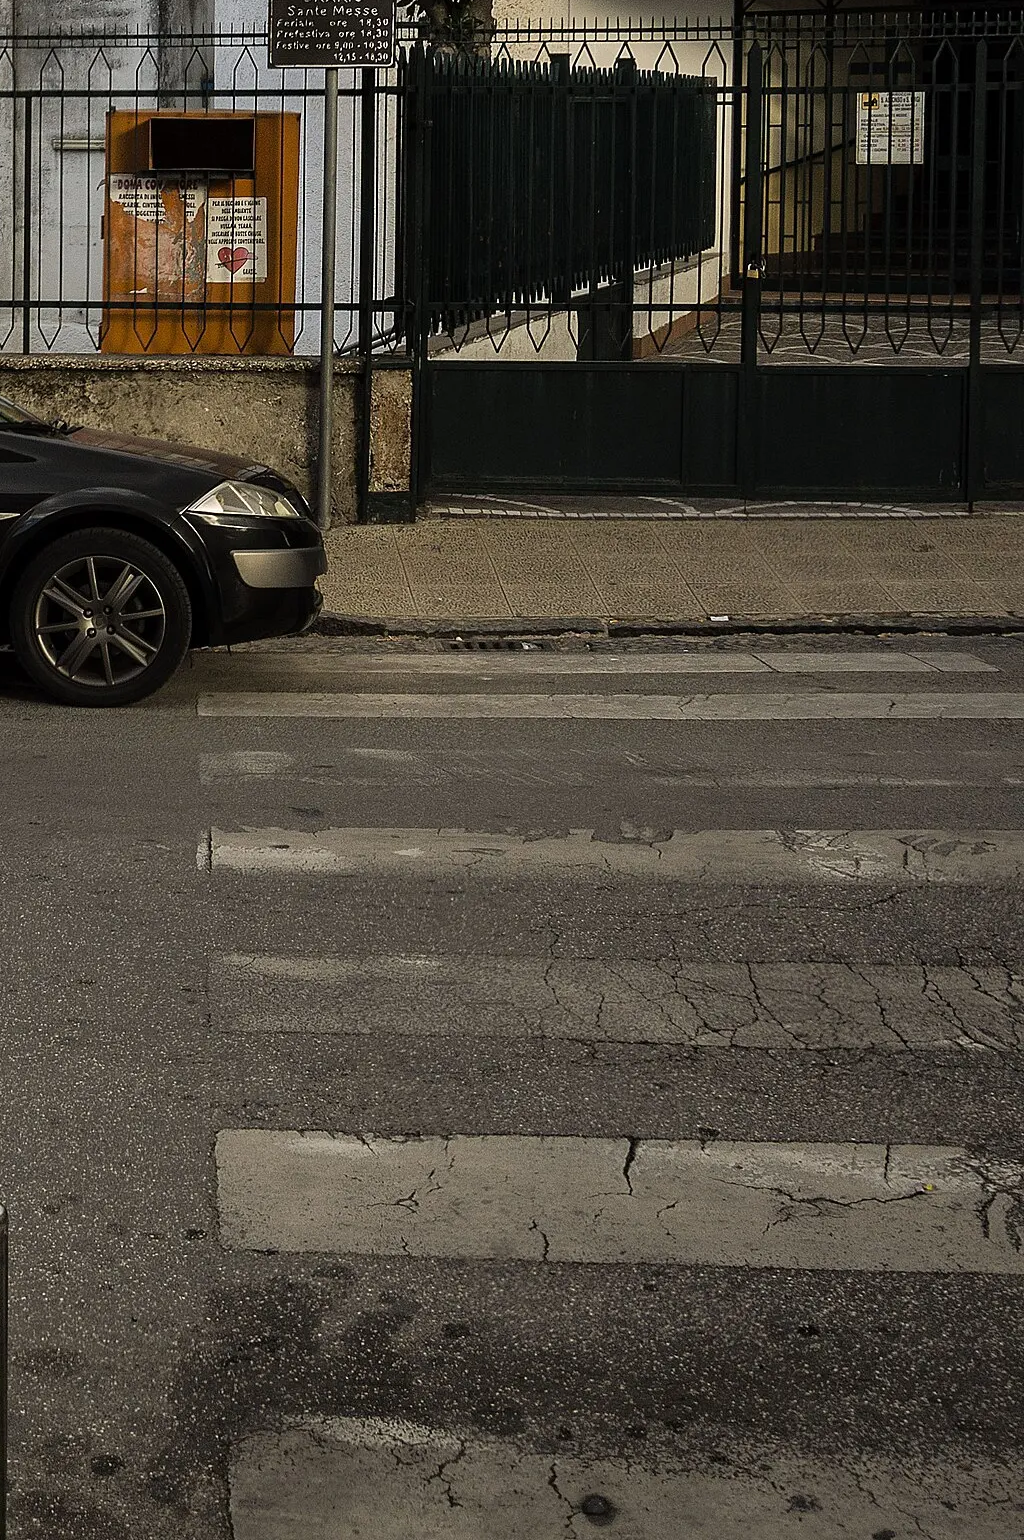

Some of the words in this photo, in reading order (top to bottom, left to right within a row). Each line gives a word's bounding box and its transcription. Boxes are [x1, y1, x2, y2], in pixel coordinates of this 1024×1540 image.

[287, 5, 327, 16] Sante
[332, 5, 379, 17] Messe
[276, 41, 310, 50] Festive
